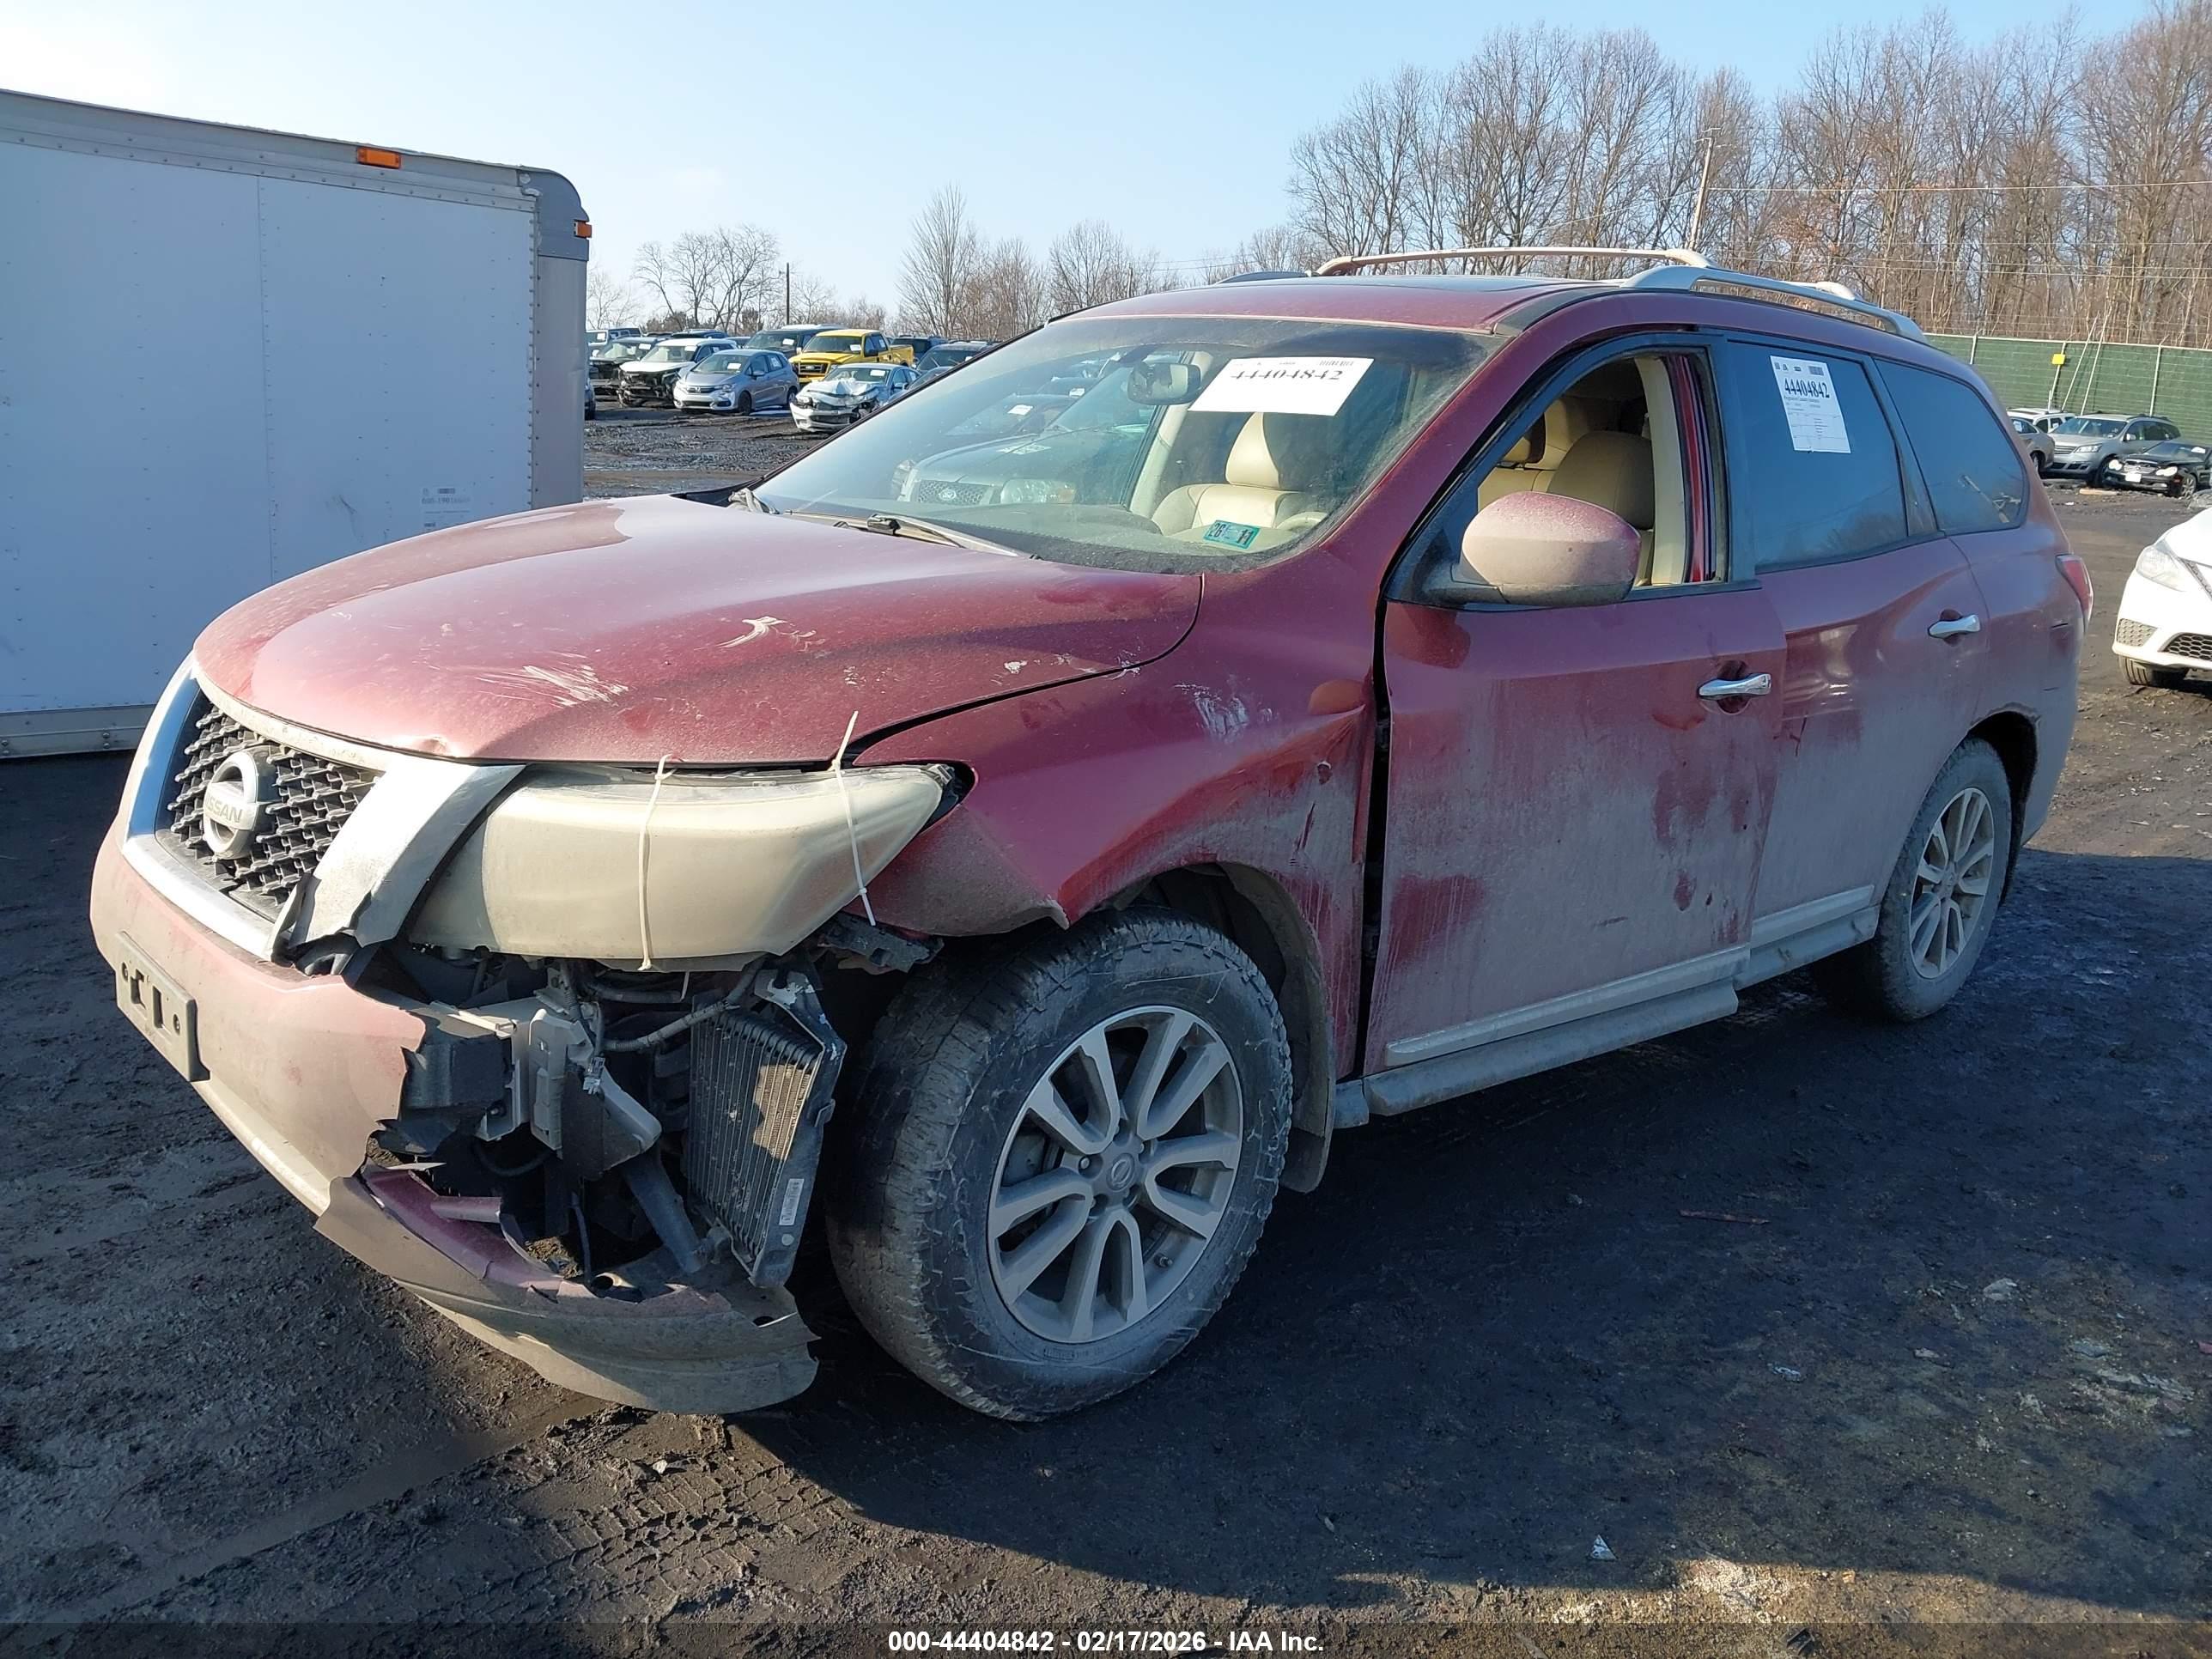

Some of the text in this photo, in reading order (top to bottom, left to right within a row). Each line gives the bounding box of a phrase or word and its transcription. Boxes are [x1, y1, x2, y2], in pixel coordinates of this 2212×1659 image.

[1230, 369, 1343, 380] 44404842
[1784, 377, 1831, 398] 44404842
[1207, 522, 1255, 545] 26 11
[204, 792, 243, 823] ISSAN
